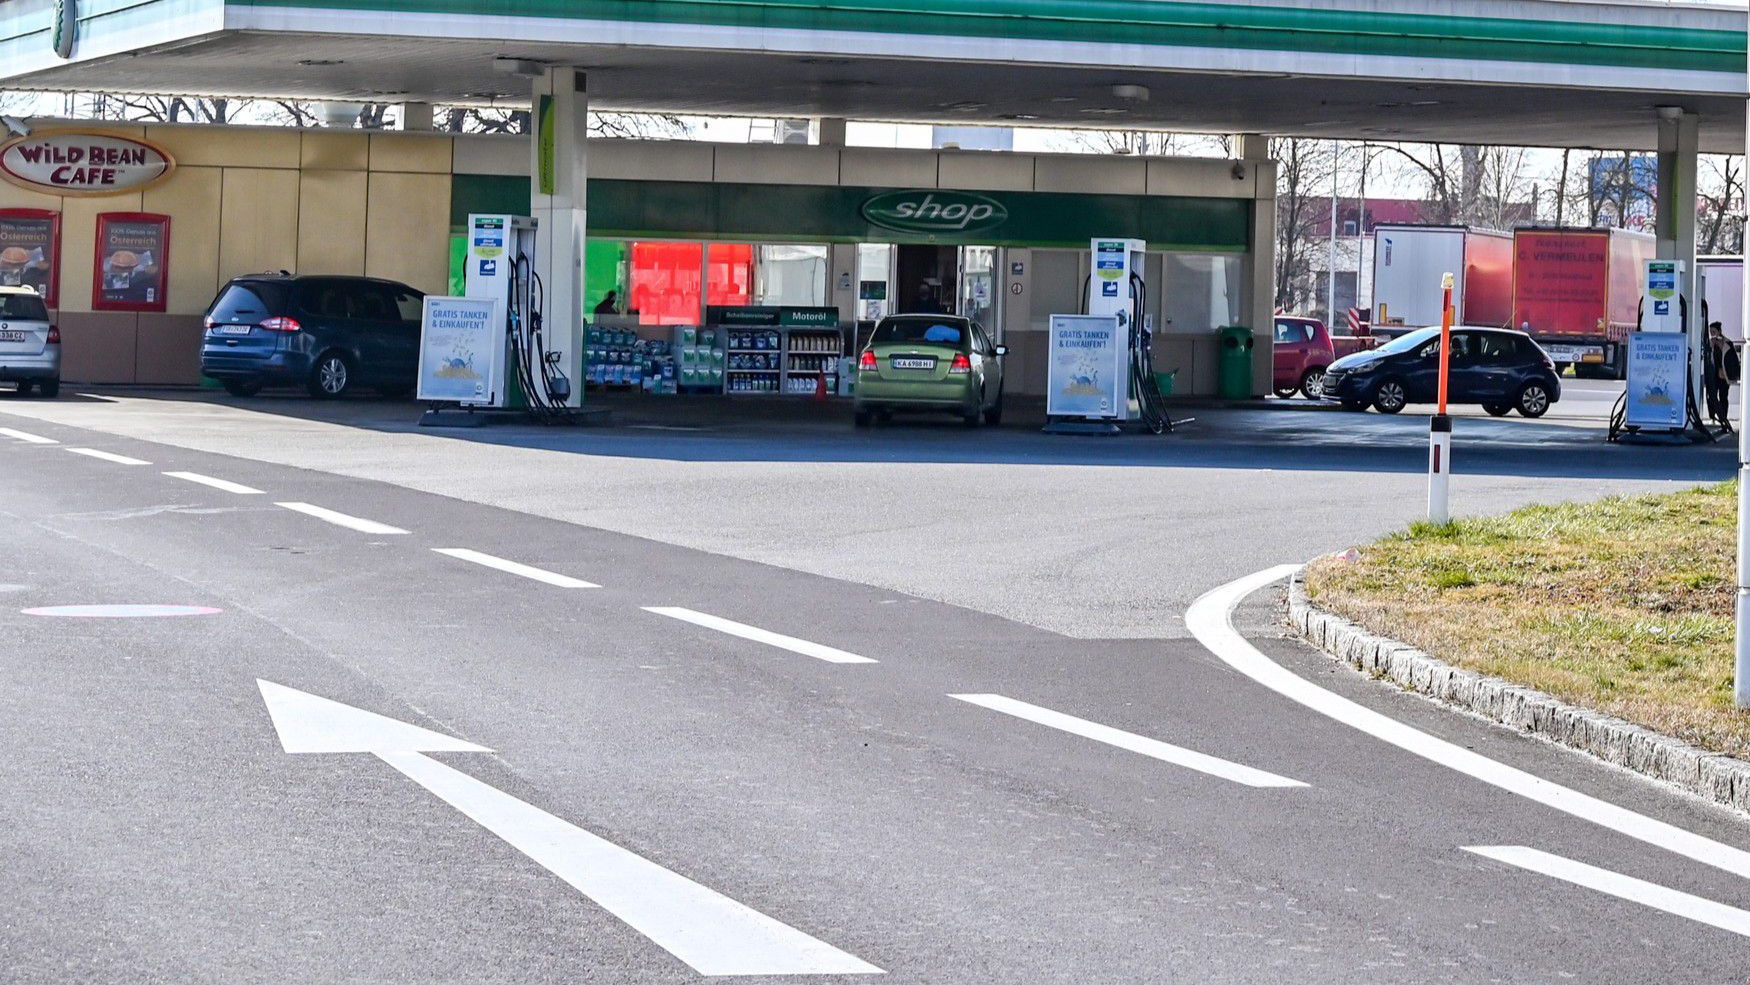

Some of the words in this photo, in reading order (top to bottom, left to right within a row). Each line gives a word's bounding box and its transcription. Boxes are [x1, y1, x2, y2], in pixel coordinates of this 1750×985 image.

[88, 145, 146, 165] BEAN
[50, 166, 117, 185] CAFE
[895, 194, 994, 229] shop
[432, 309, 458, 319] GRATIS
[460, 310, 488, 320] TANKEN
[792, 311, 827, 321] Motoröl
[1059, 330, 1082, 339] GRATIS
[1084, 330, 1110, 340] TANKEN
